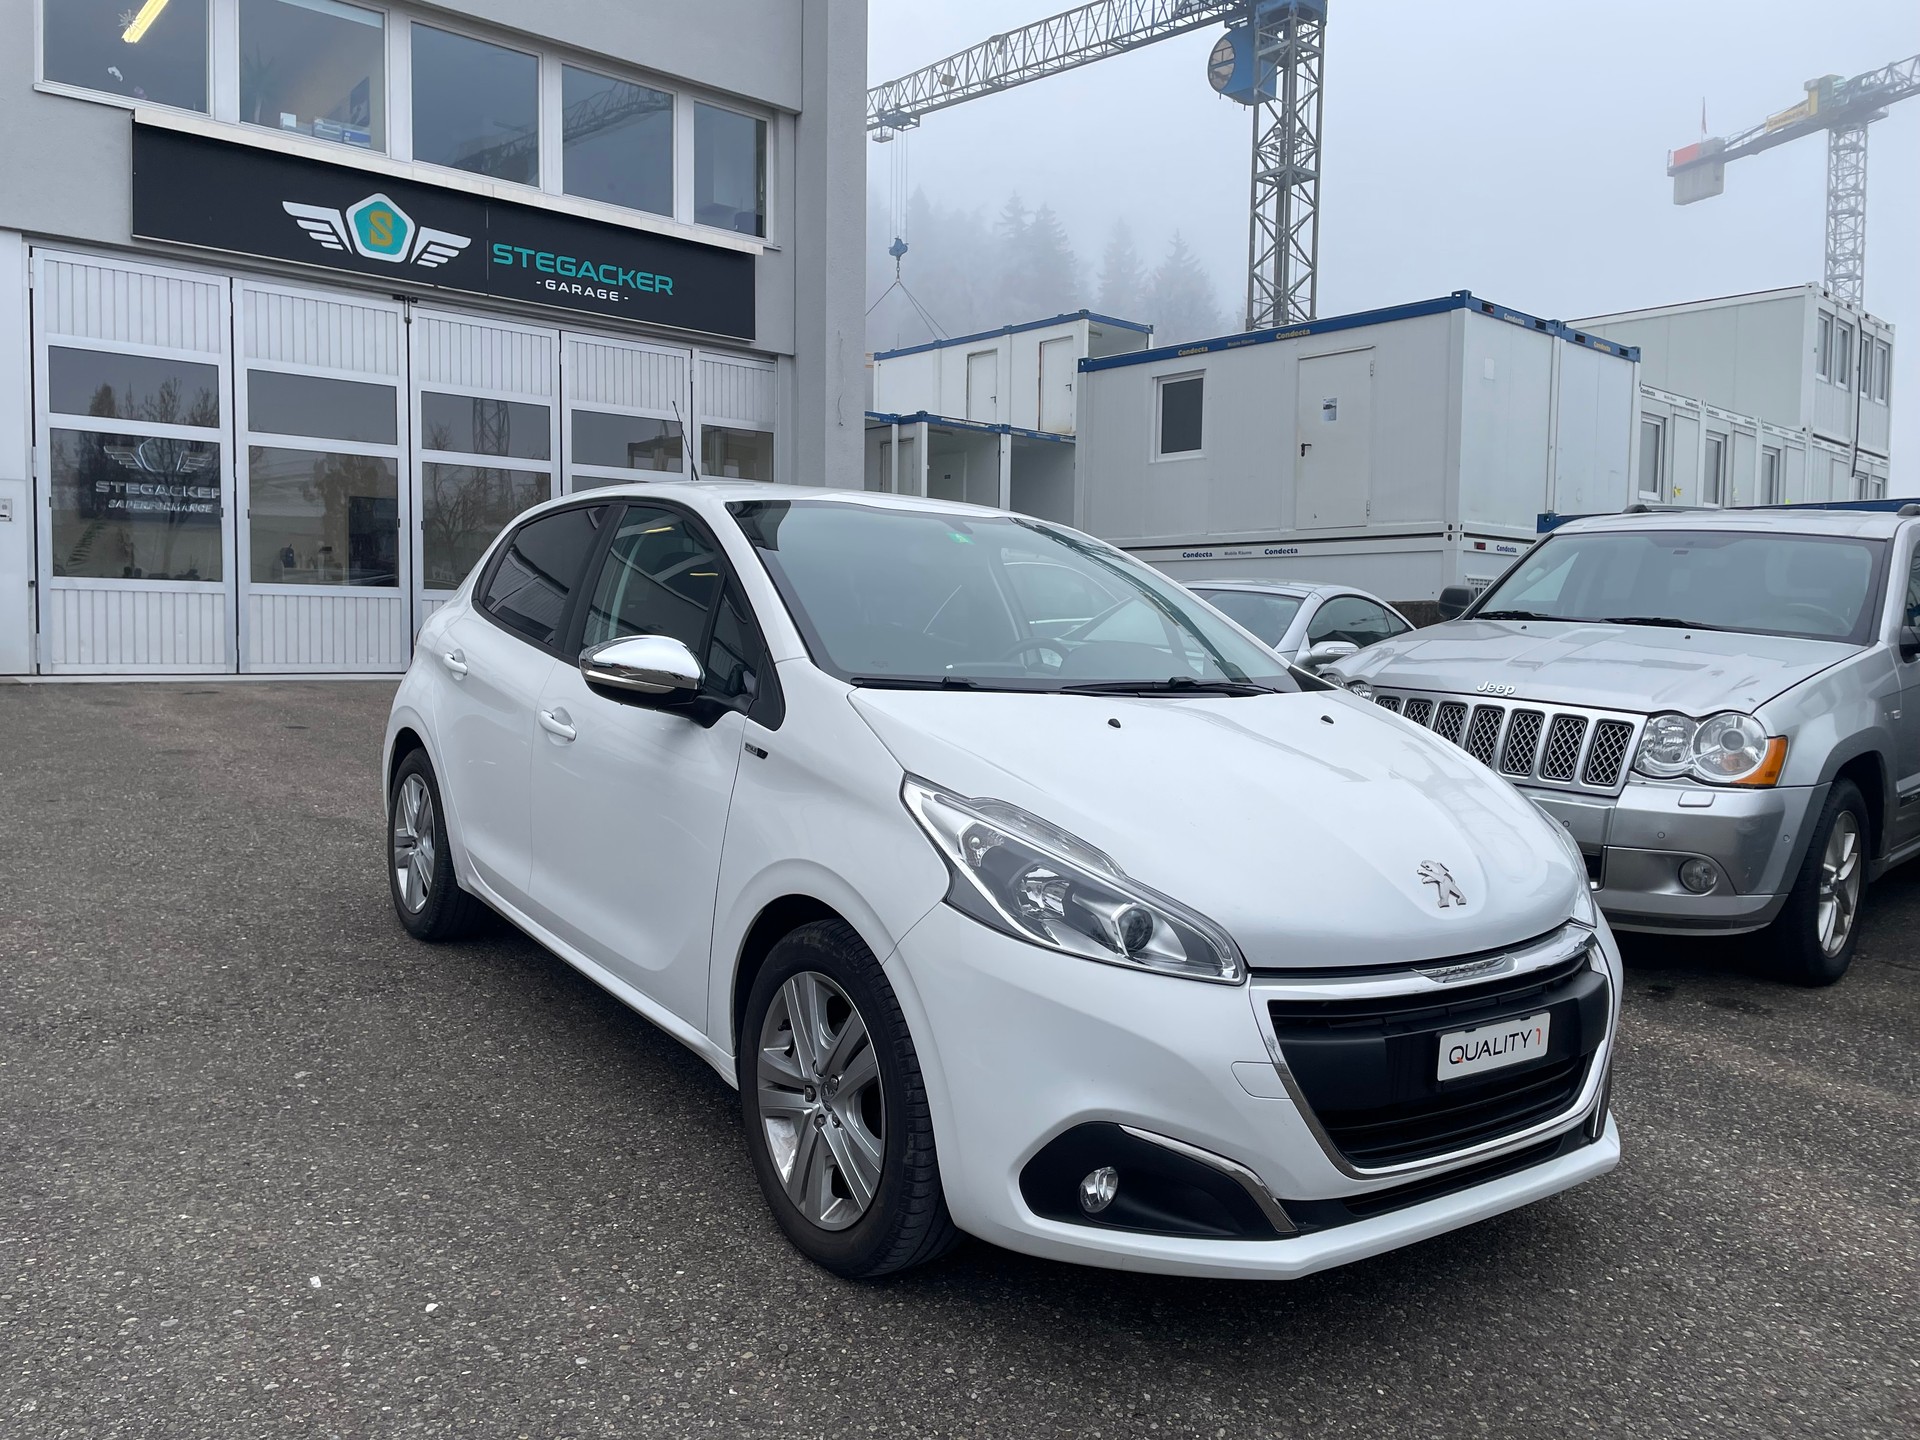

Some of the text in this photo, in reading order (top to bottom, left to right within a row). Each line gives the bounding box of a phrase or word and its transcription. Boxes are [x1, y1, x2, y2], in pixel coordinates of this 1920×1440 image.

[369, 210, 393, 246] S
[492, 243, 674, 296] STEGACKER
[1177, 346, 1208, 356] Condecta
[1276, 328, 1310, 339] Condecta
[1182, 551, 1213, 559] Condecta
[1264, 547, 1299, 556] Condecta
[1476, 681, 1516, 696] Jeep
[1449, 1029, 1532, 1064] QUALITY
